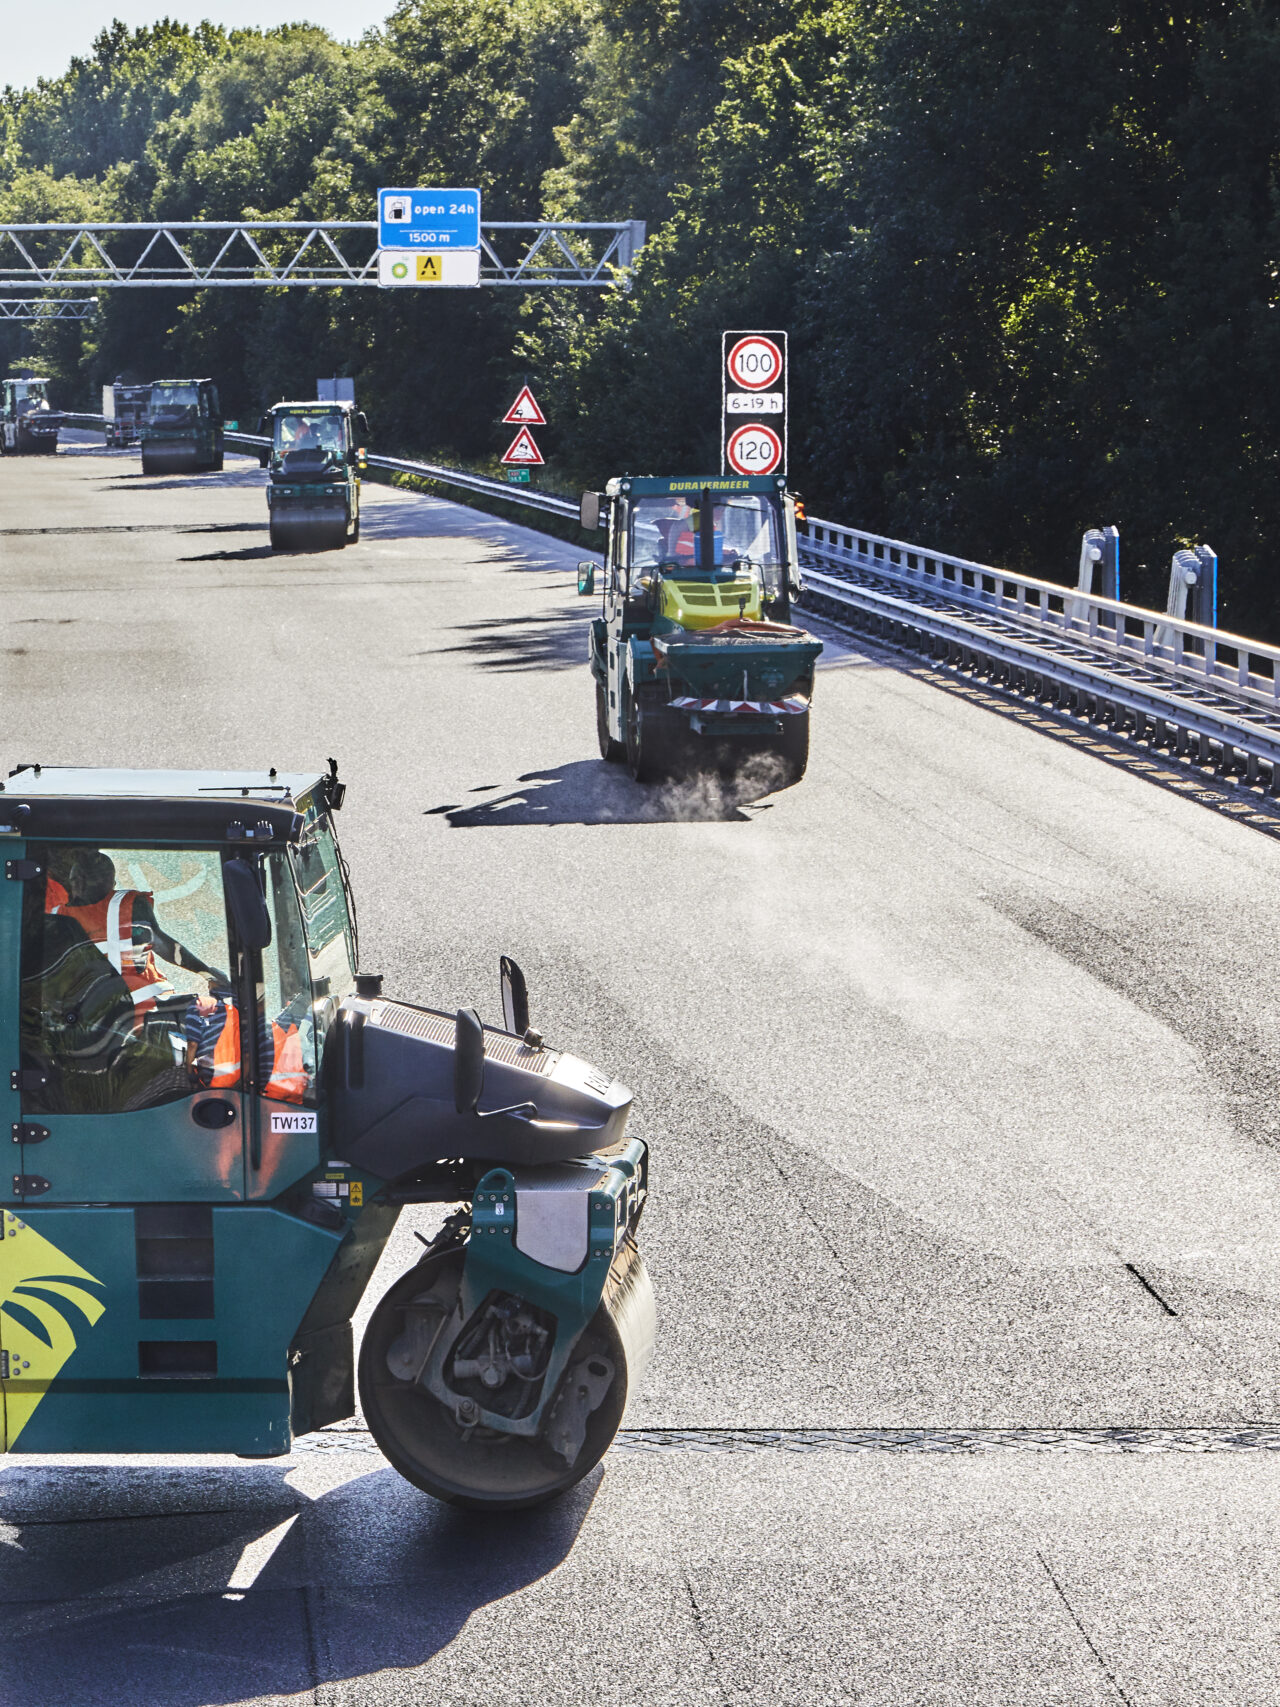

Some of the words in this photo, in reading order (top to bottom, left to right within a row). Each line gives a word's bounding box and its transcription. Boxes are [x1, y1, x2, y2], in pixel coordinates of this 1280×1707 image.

[414, 205, 445, 215] open
[449, 204, 474, 214] 24h
[409, 233, 436, 242] 1500
[439, 234, 450, 242] m
[739, 354, 772, 372] 100
[732, 398, 764, 409] 6-19
[771, 398, 778, 409] h
[738, 441, 772, 460] 120
[272, 1117, 314, 1129] TW137
